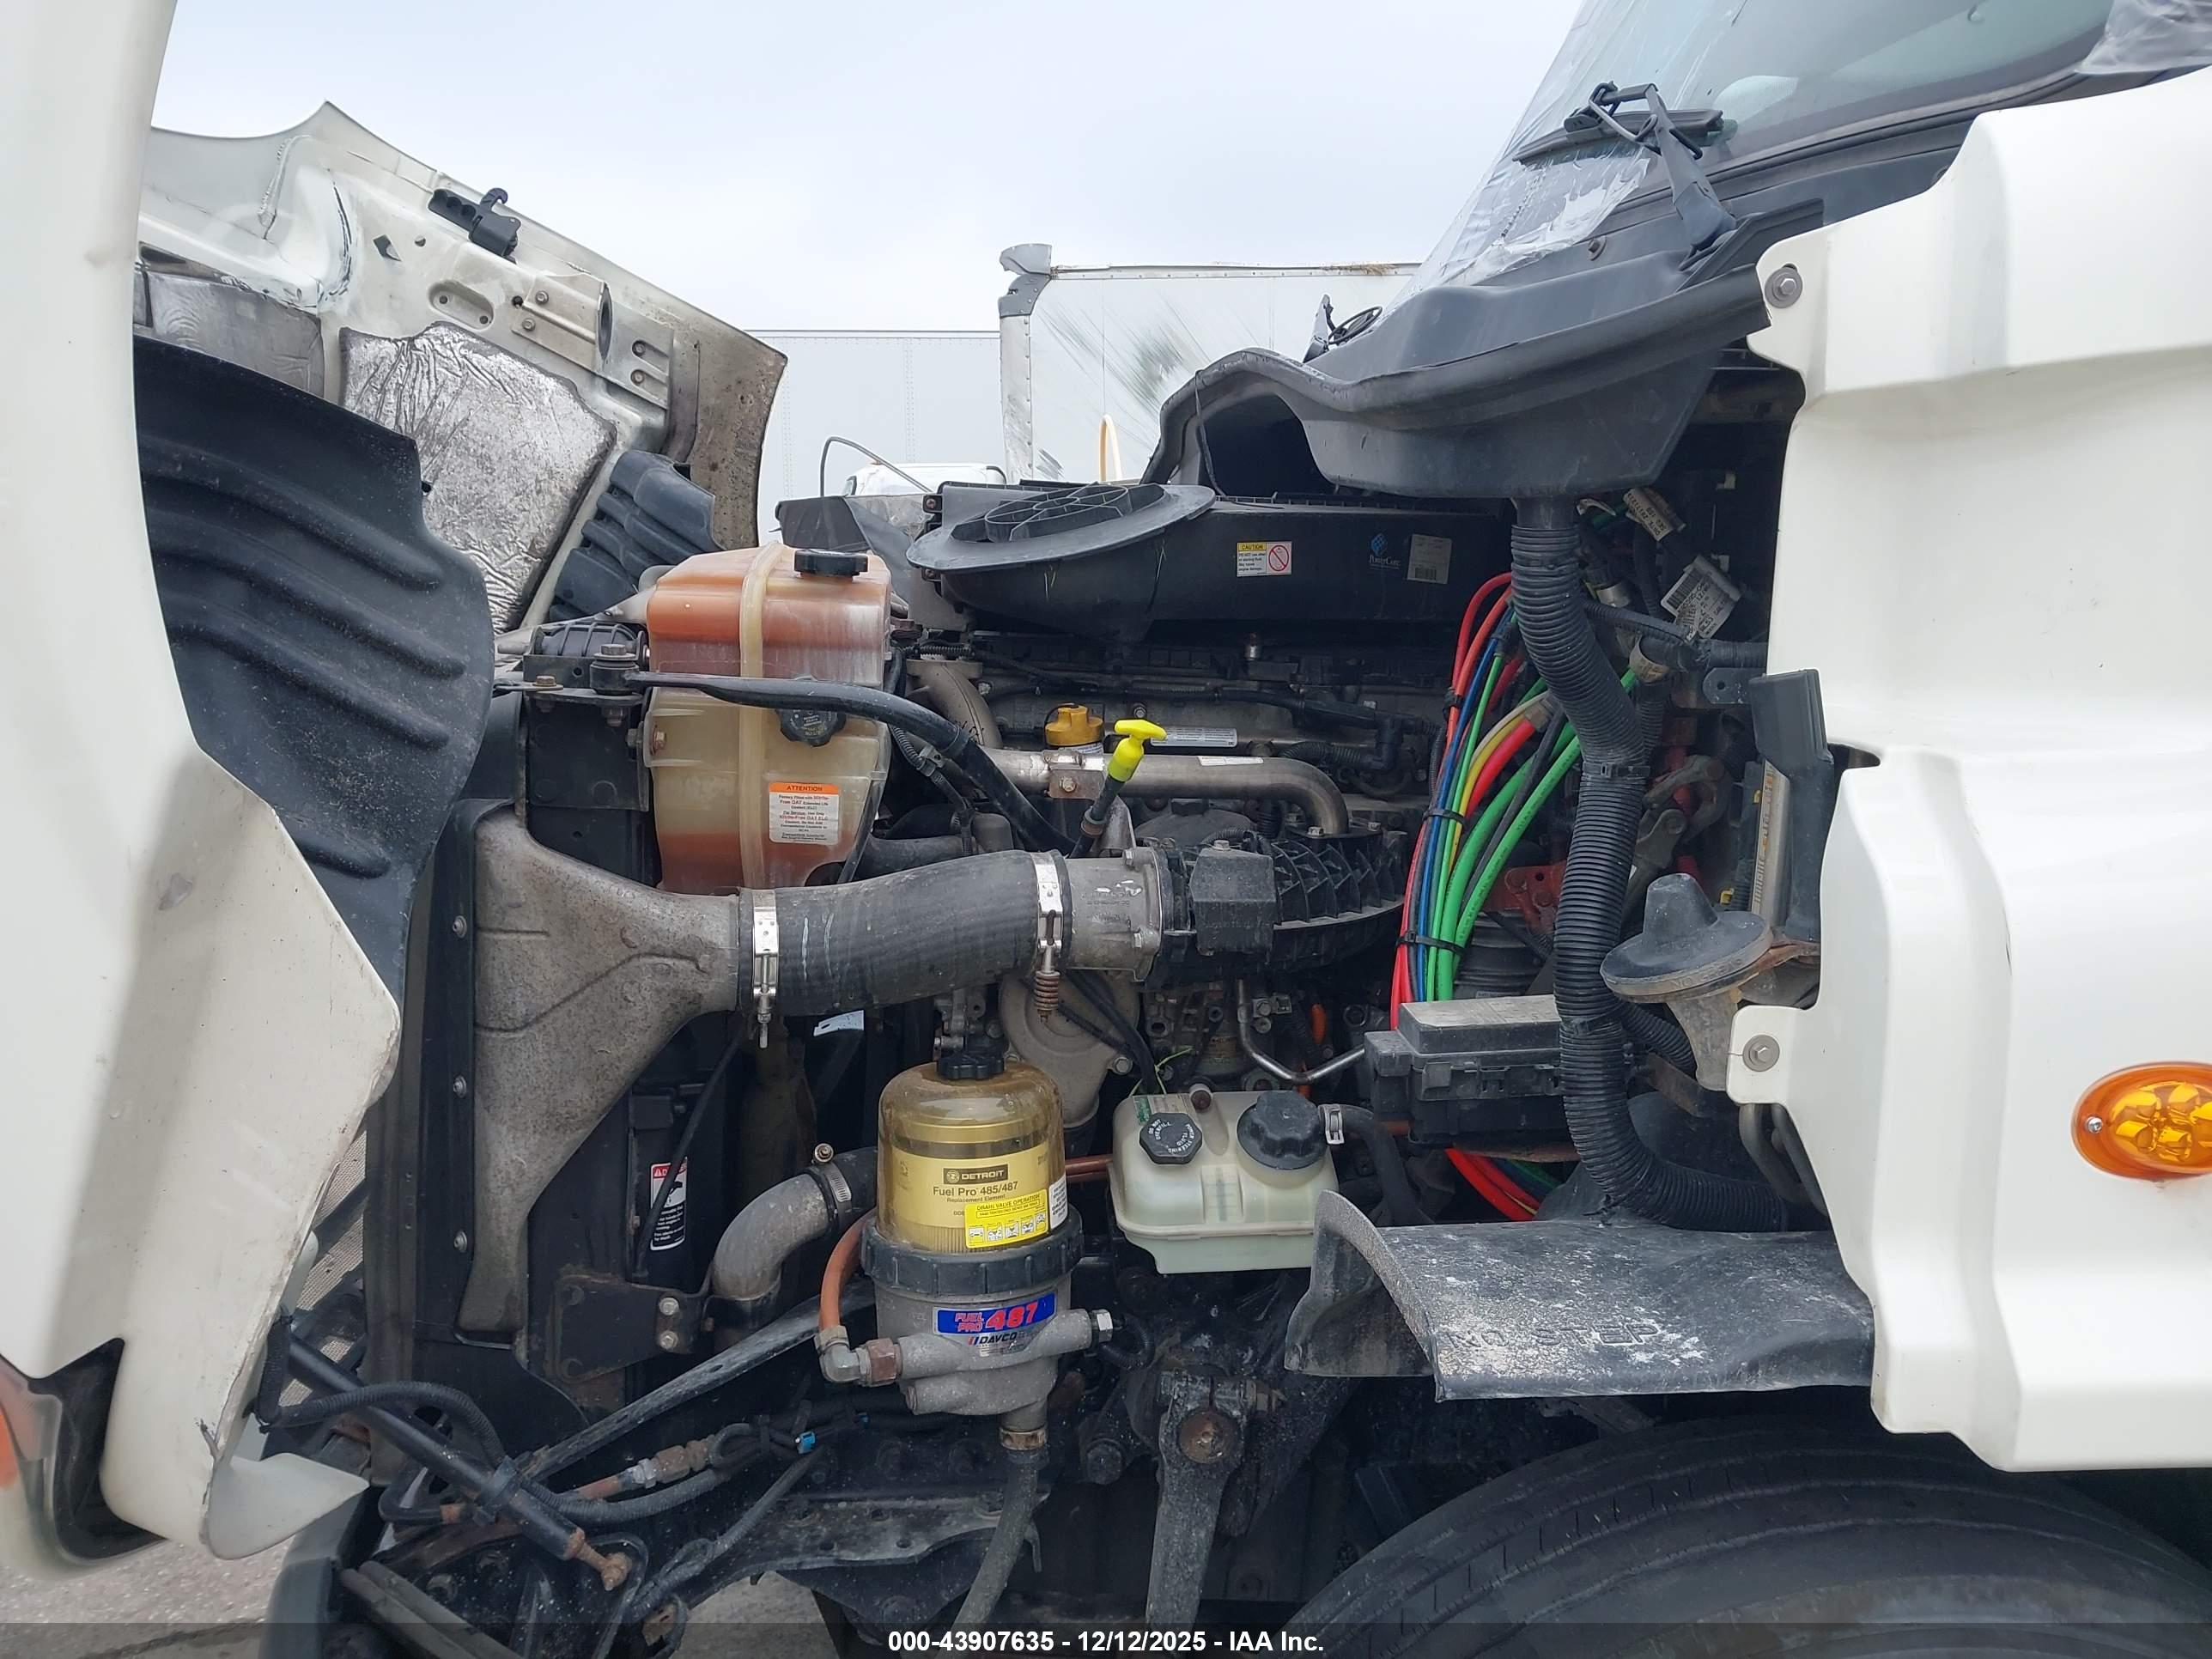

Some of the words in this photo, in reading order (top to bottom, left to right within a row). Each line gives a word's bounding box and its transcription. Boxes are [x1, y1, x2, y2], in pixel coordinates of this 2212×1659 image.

[1152, 1119, 1161, 1127] NOT
[1185, 1123, 1194, 1139] POWER
[1176, 1133, 1188, 1146] FLUID
[962, 1170, 1005, 1180] DETROIT
[933, 1186, 955, 1196] Fuel
[958, 1187, 977, 1196] Pro
[980, 1181, 1018, 1195] 485/487
[976, 1202, 994, 1211] DRAIN
[995, 1200, 1012, 1209] VALVE
[1013, 1194, 1041, 1206] OPERATION
[955, 1312, 984, 1322] FUEL
[985, 1300, 1038, 1330] 487
[957, 1322, 983, 1332] PRO
[979, 1332, 1018, 1344] DAVCO
[1531, 1322, 1661, 1346] STEP
